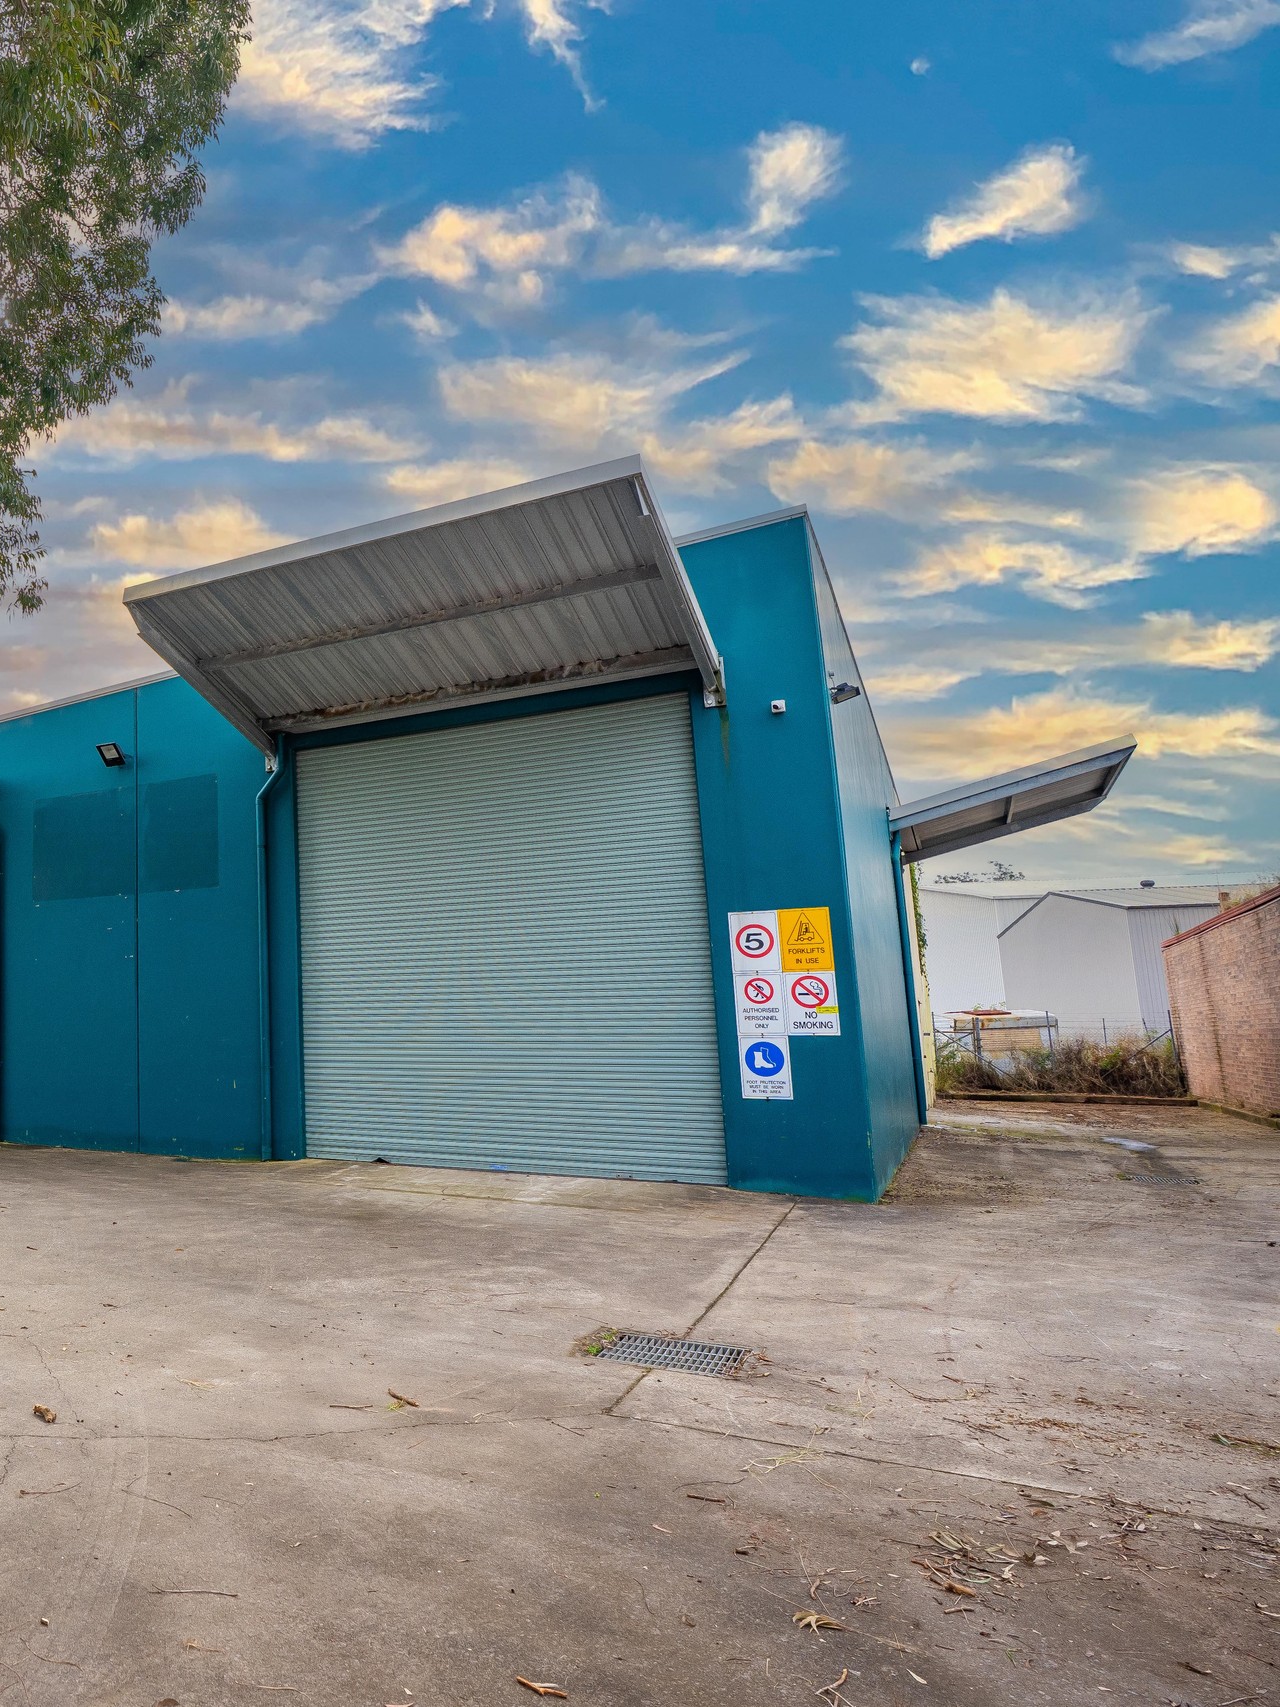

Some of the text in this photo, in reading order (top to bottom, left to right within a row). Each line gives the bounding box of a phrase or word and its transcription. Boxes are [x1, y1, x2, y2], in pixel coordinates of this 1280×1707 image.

[744, 932, 765, 951] 5
[788, 947, 825, 955] FORKLIFTS
[804, 1011, 818, 1020] NO
[793, 1020, 834, 1030] SMOKING
